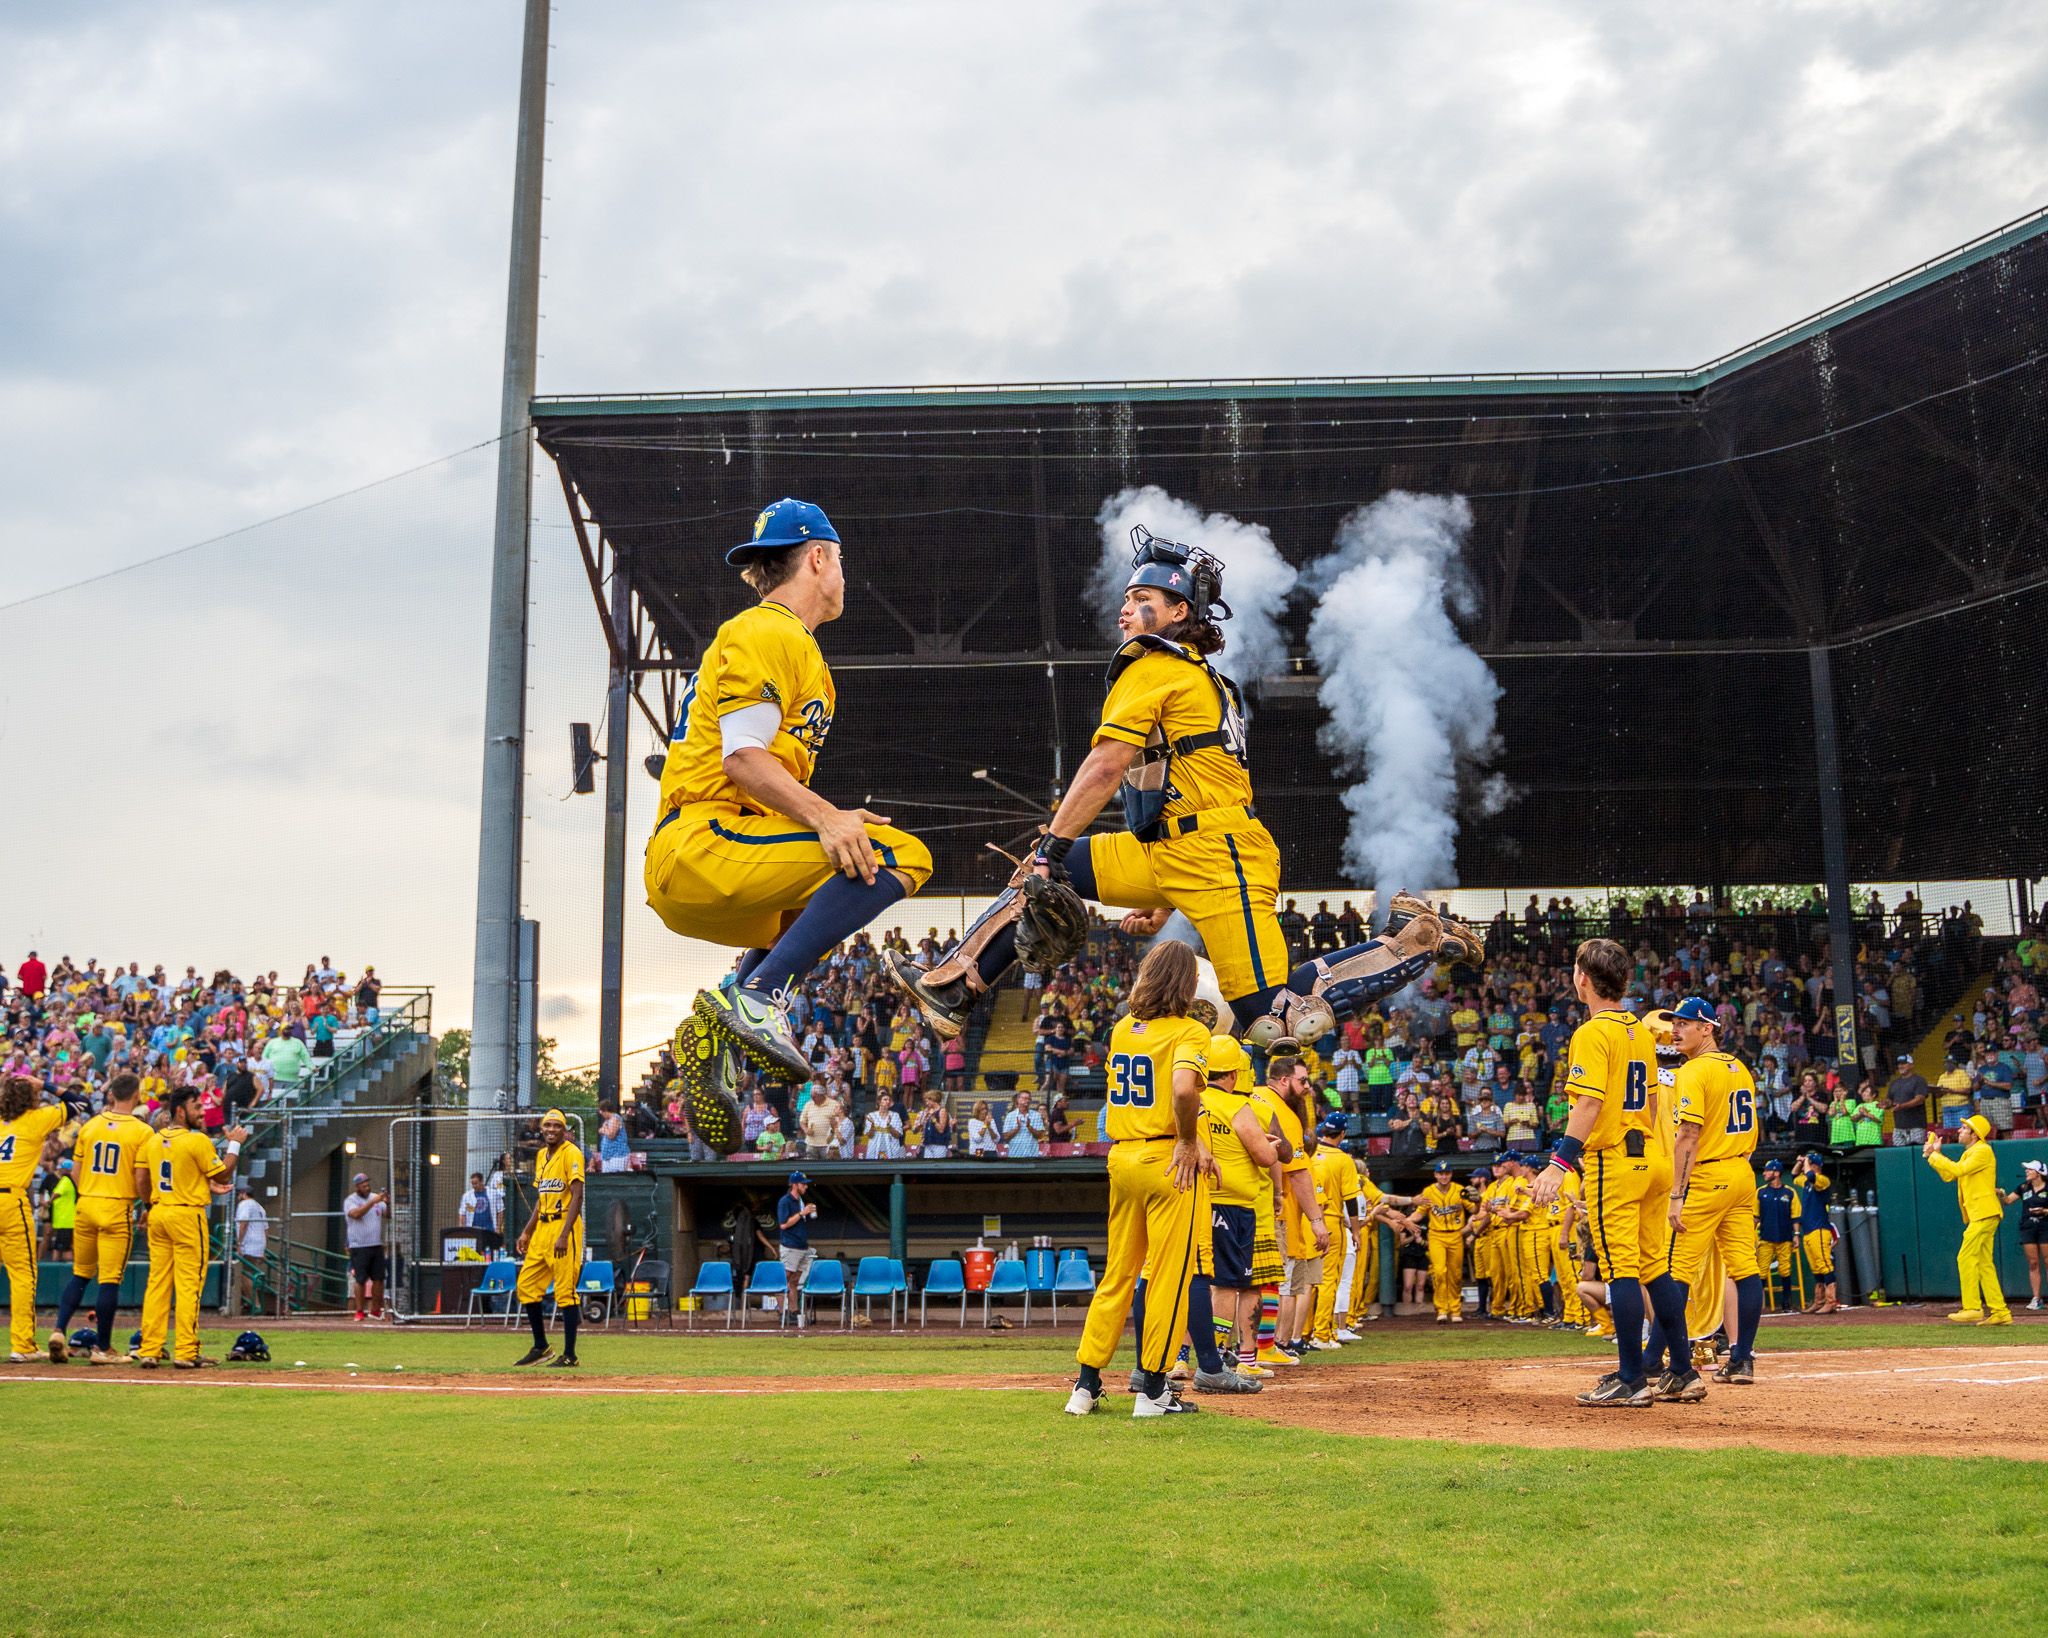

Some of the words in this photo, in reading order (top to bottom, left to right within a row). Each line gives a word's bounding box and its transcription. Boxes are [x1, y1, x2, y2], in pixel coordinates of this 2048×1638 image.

[1109, 1052, 1155, 1108] 39
[1726, 1088, 1754, 1134] 16
[92, 1141, 120, 1174] 10
[158, 1160, 174, 1192] 9
